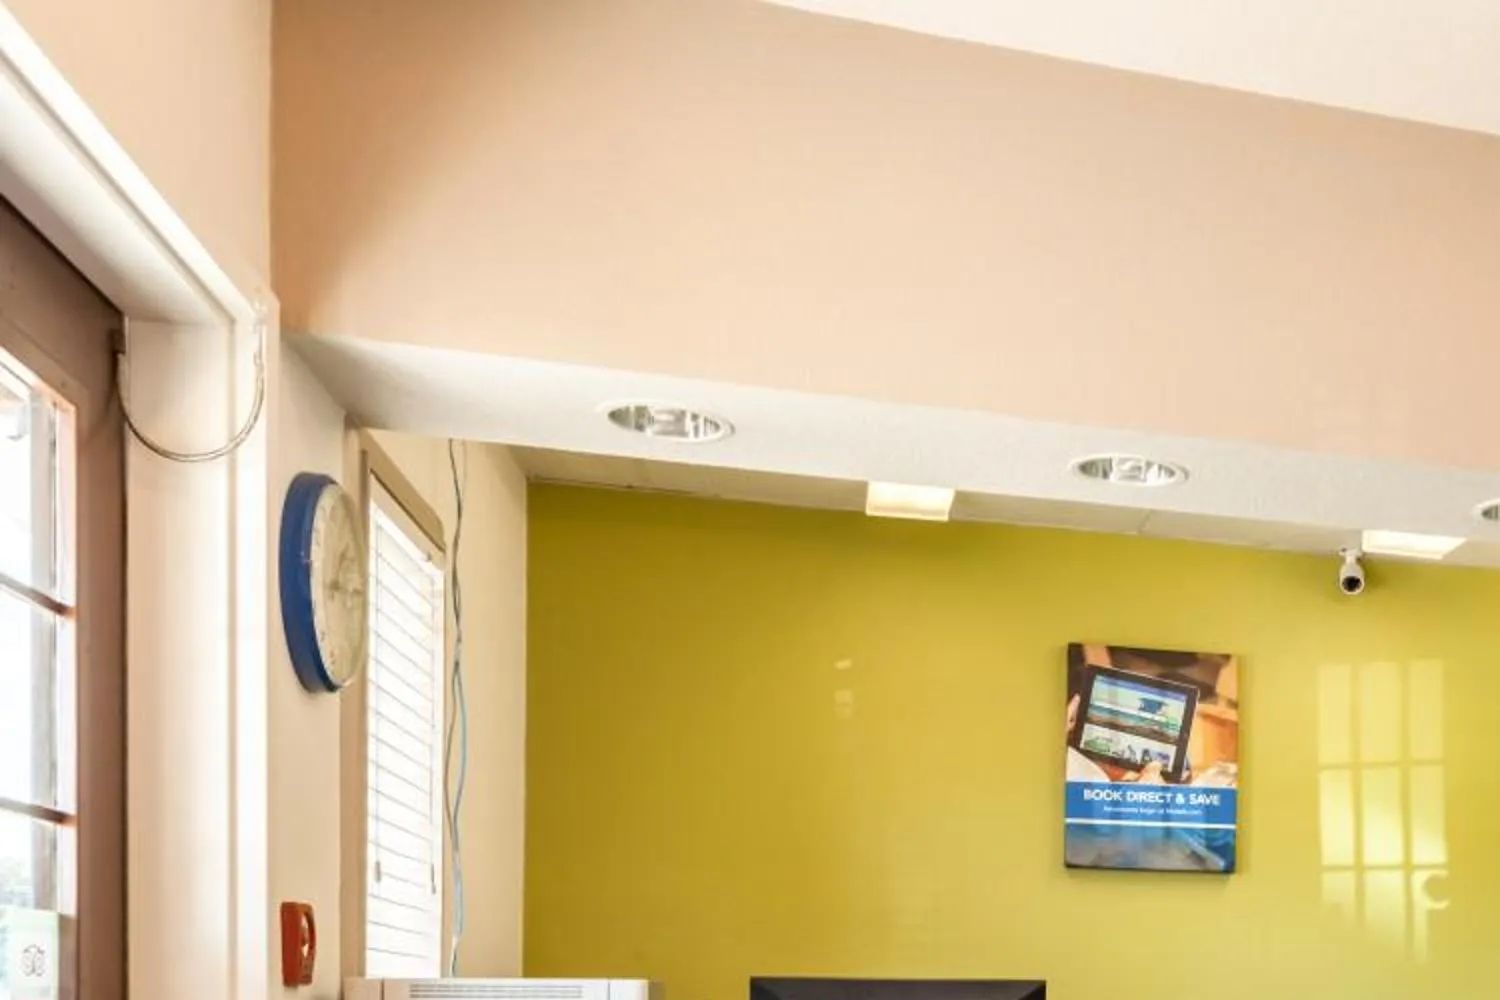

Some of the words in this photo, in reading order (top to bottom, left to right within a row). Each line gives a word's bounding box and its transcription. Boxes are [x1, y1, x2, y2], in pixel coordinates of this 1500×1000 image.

[1083, 788, 1122, 801] BOOK
[1126, 791, 1172, 804] DIRECT
[1175, 792, 1185, 805] &
[1189, 793, 1221, 806] SAVE
